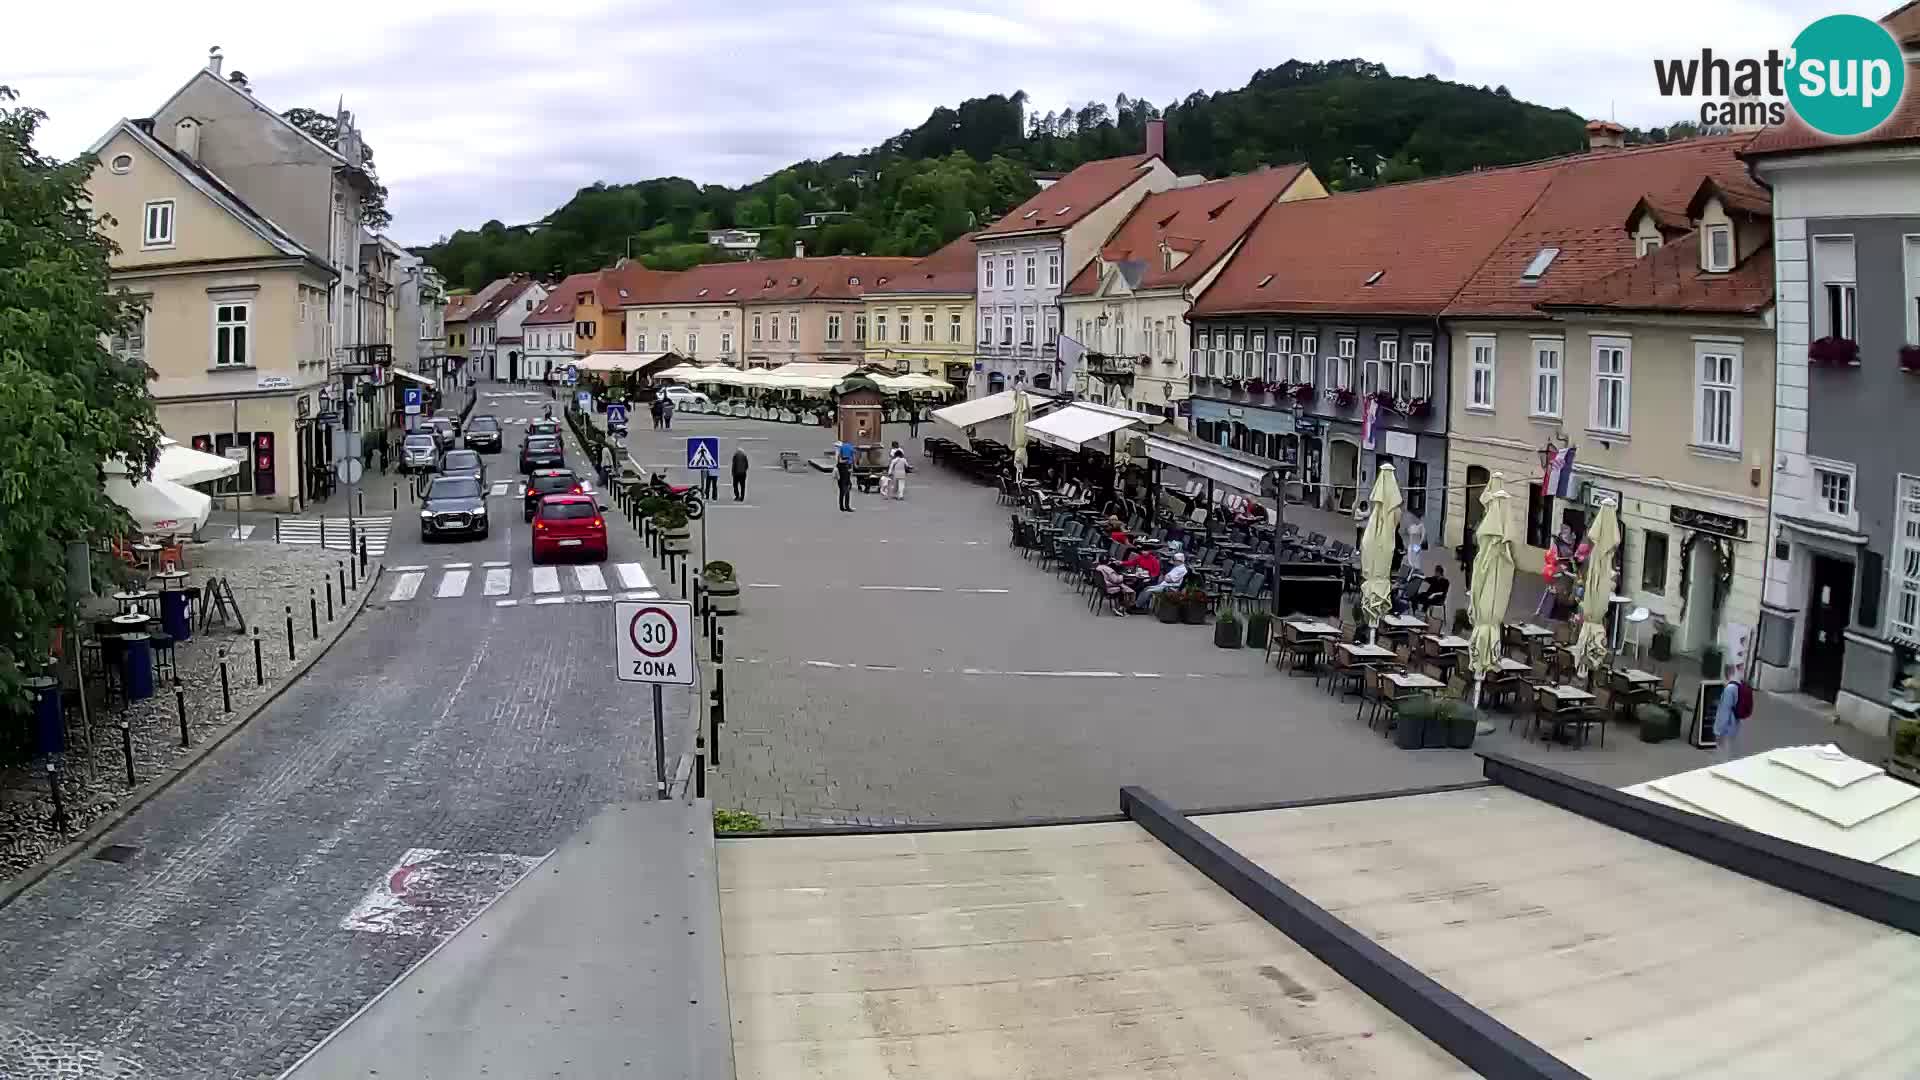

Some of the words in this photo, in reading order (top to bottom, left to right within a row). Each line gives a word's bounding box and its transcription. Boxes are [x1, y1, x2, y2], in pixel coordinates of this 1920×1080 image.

[409, 391, 417, 402] P
[642, 623, 666, 644] 30
[633, 660, 677, 677] ZONA
